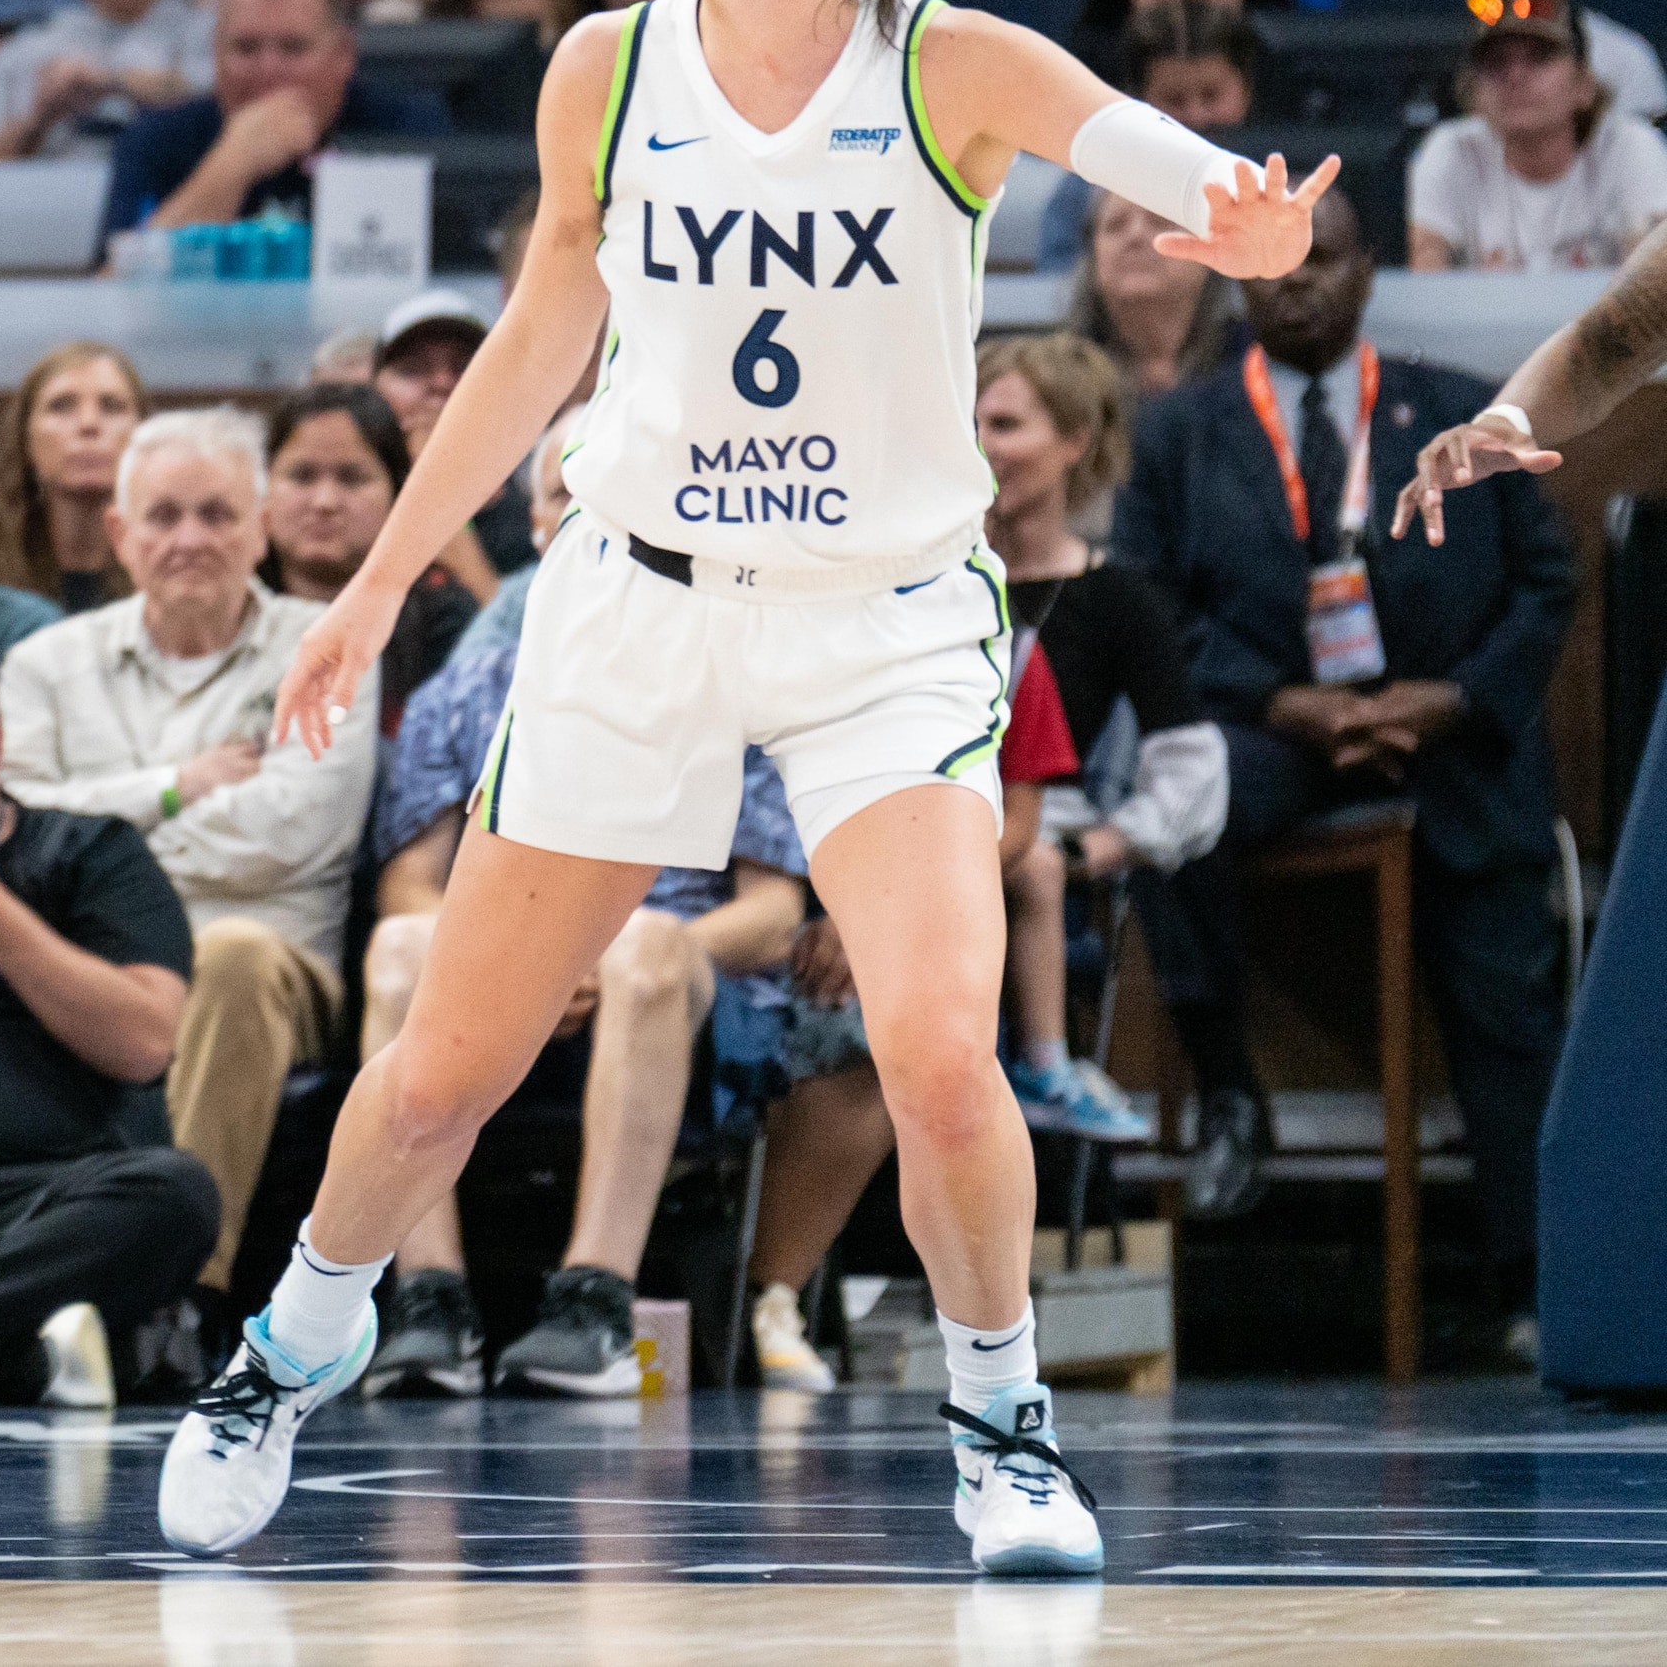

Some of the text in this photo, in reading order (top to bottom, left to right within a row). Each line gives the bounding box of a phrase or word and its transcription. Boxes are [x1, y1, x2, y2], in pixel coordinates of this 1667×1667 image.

[830, 127, 901, 144] FEDERATED
[643, 200, 900, 289] LYNX
[732, 307, 801, 408] 6
[690, 434, 837, 474] MAYO
[675, 484, 849, 526] CLINIC
